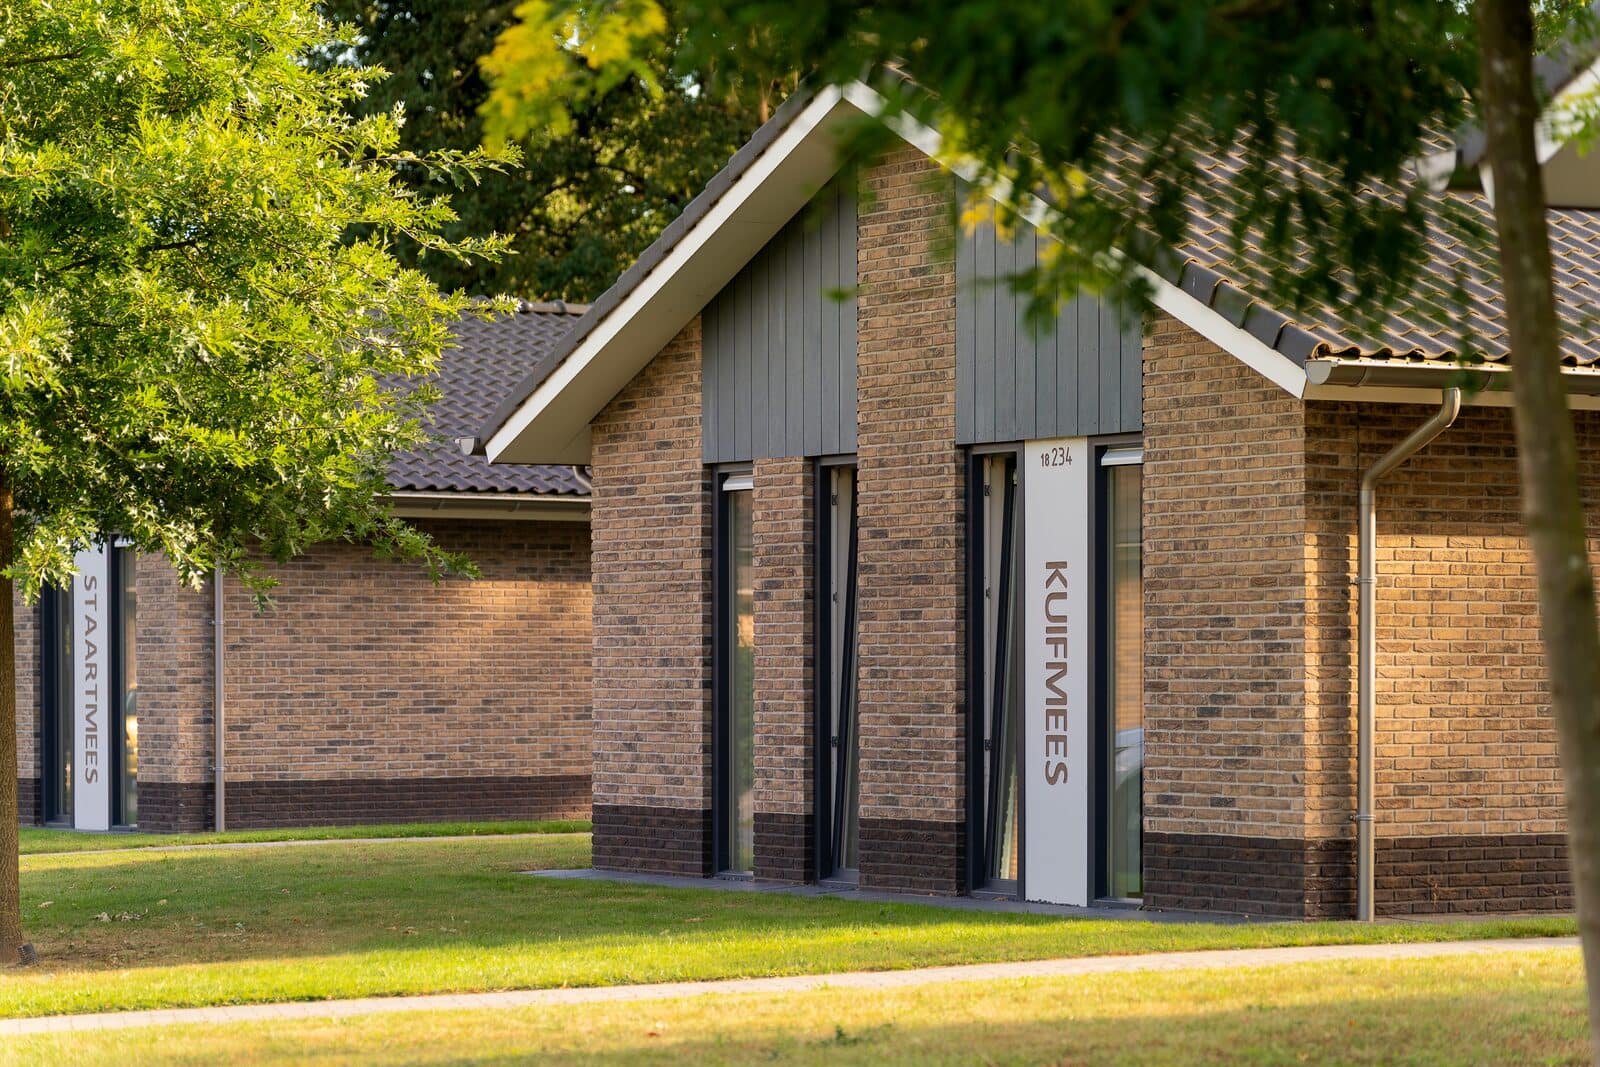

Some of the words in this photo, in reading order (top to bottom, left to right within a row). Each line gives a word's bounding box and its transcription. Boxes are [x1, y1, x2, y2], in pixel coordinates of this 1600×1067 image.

[1040, 452, 1050, 468] 18
[1051, 446, 1073, 467] 234
[83, 575, 98, 785] STAARTMEES
[1044, 560, 1068, 786] KUIFMEES
